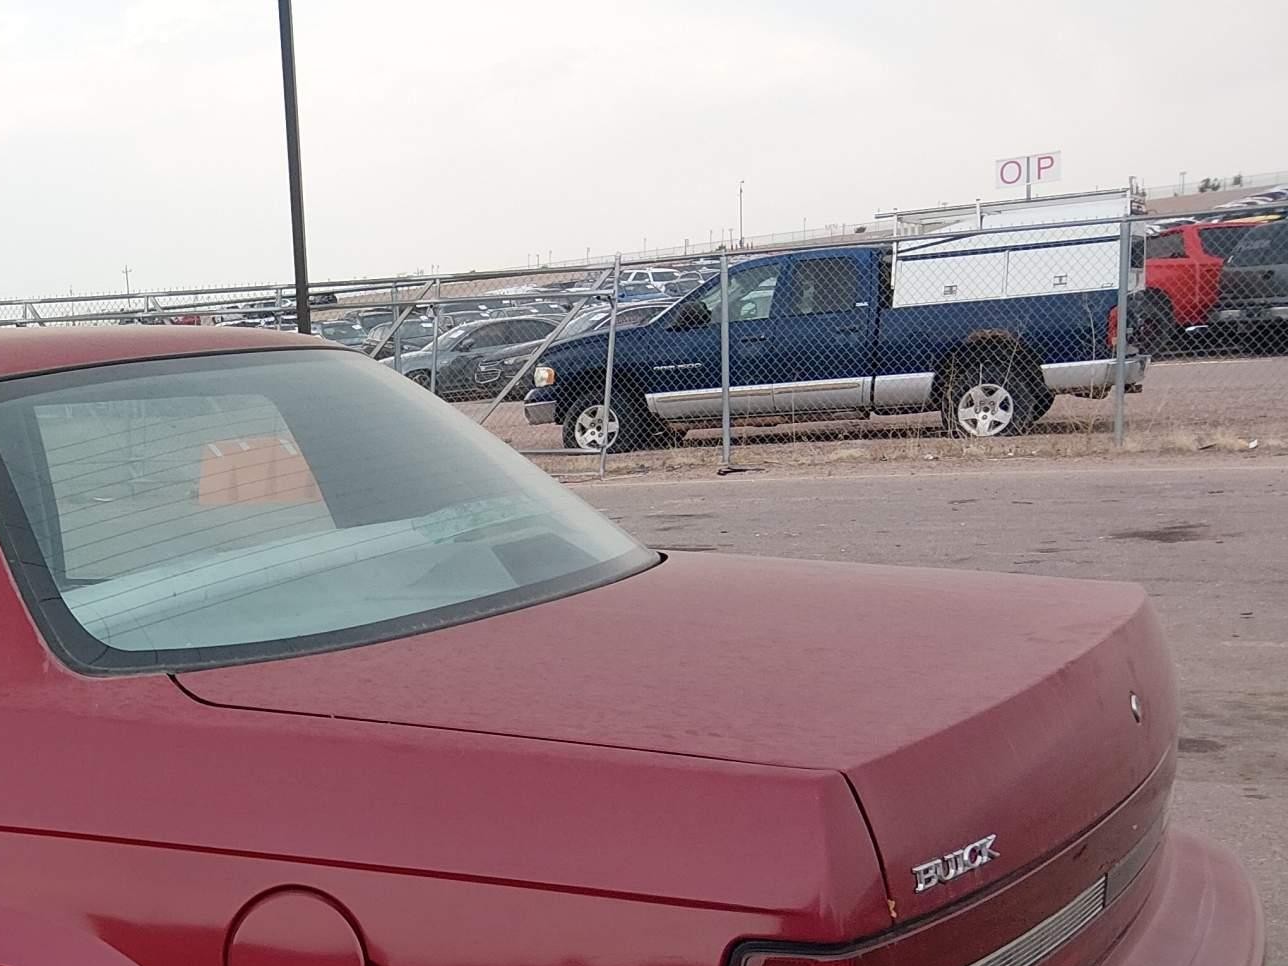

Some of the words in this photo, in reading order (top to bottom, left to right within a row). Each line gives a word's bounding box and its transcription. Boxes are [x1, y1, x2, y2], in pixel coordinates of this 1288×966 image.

[1000, 160, 1022, 184] O
[1037, 156, 1055, 180] P
[912, 834, 1001, 894] BUICK
